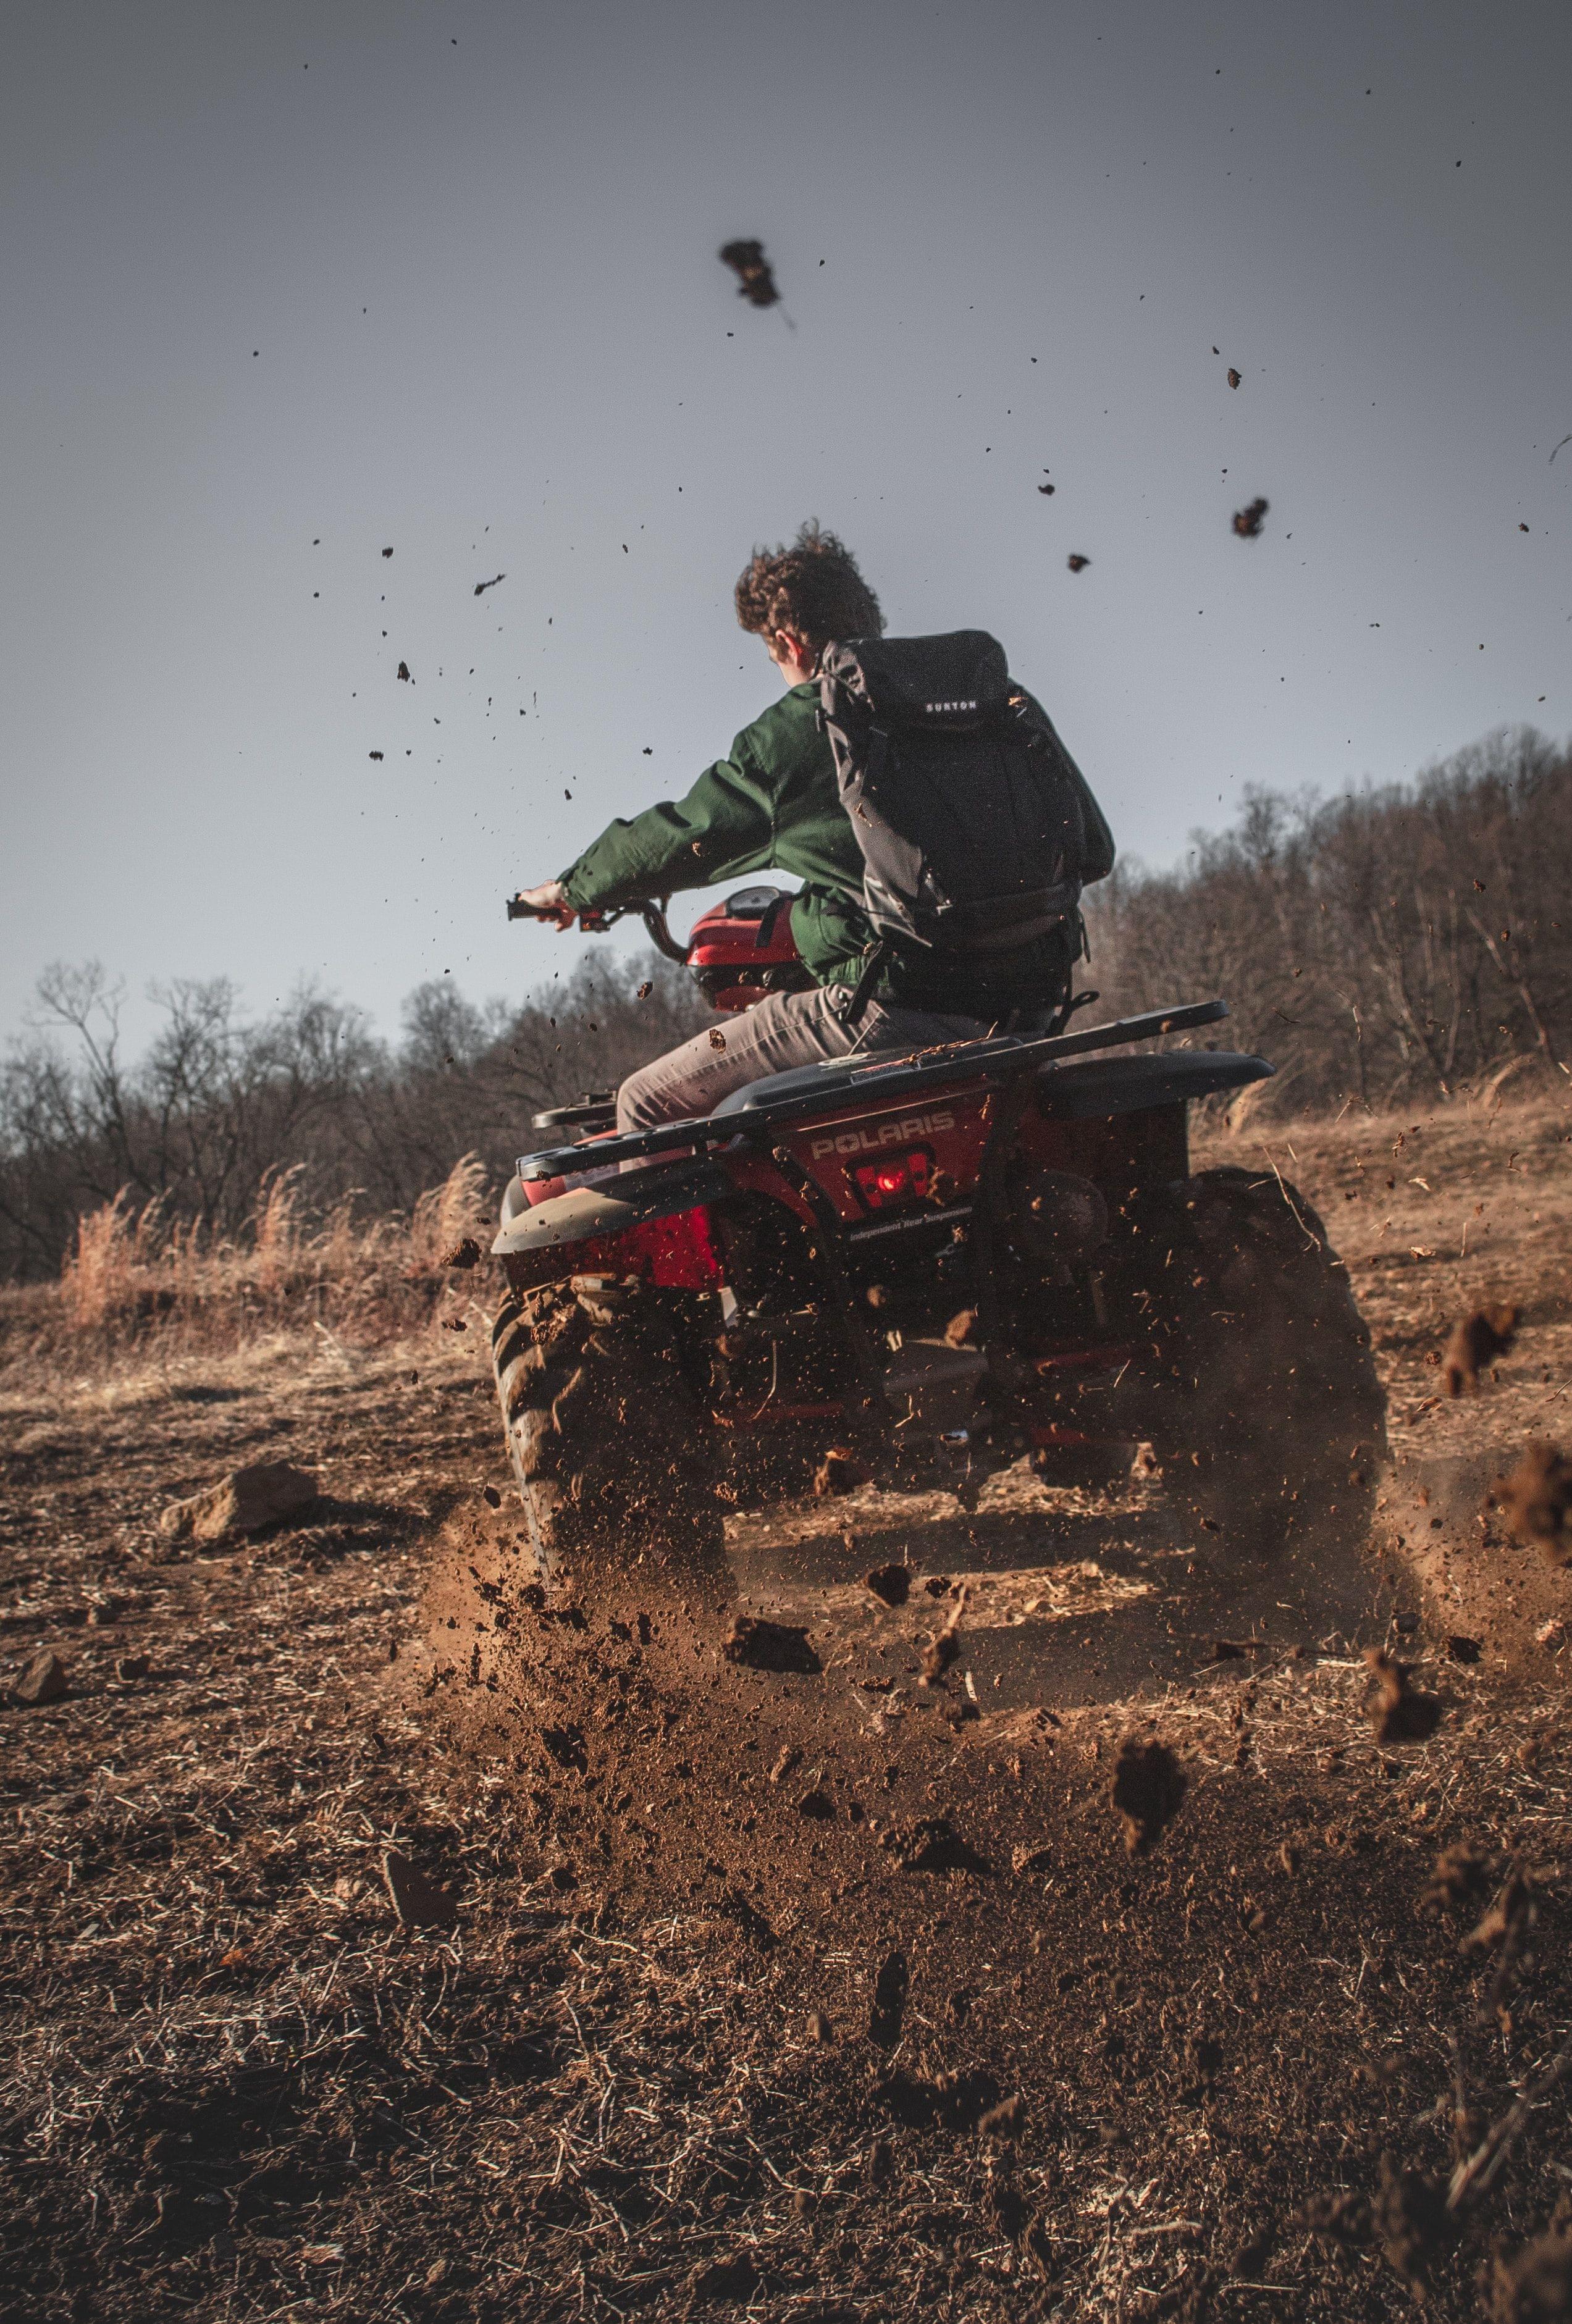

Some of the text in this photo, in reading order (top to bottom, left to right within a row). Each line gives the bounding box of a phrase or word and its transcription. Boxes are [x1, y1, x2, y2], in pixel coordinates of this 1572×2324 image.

[927, 701, 976, 713] BURTON
[810, 1112, 955, 1160] POLARIS
[850, 1222, 901, 1241] Independent
[904, 1218, 923, 1228] Rear
